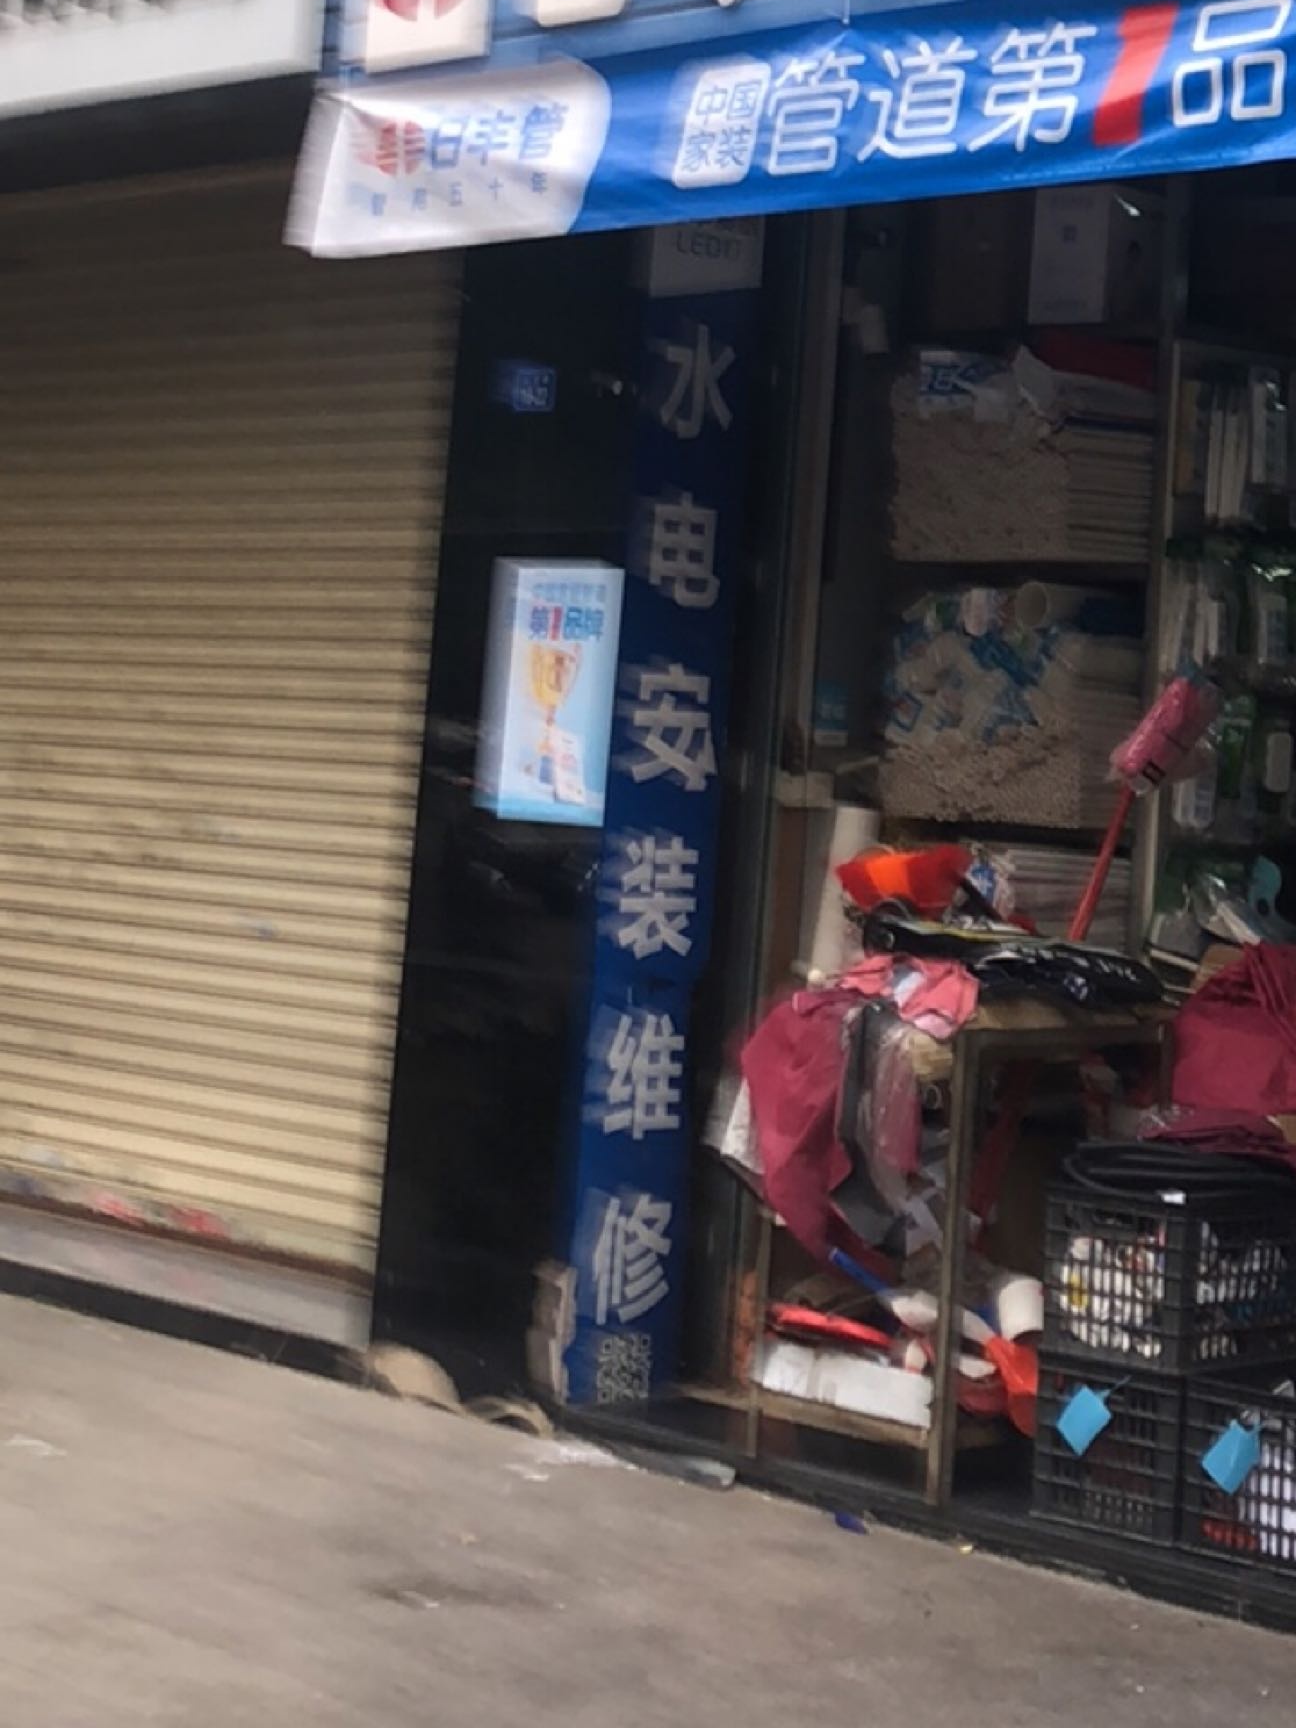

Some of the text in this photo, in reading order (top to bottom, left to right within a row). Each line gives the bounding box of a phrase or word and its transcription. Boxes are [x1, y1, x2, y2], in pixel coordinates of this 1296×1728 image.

[592, 324, 736, 1325] 水电安装维修
